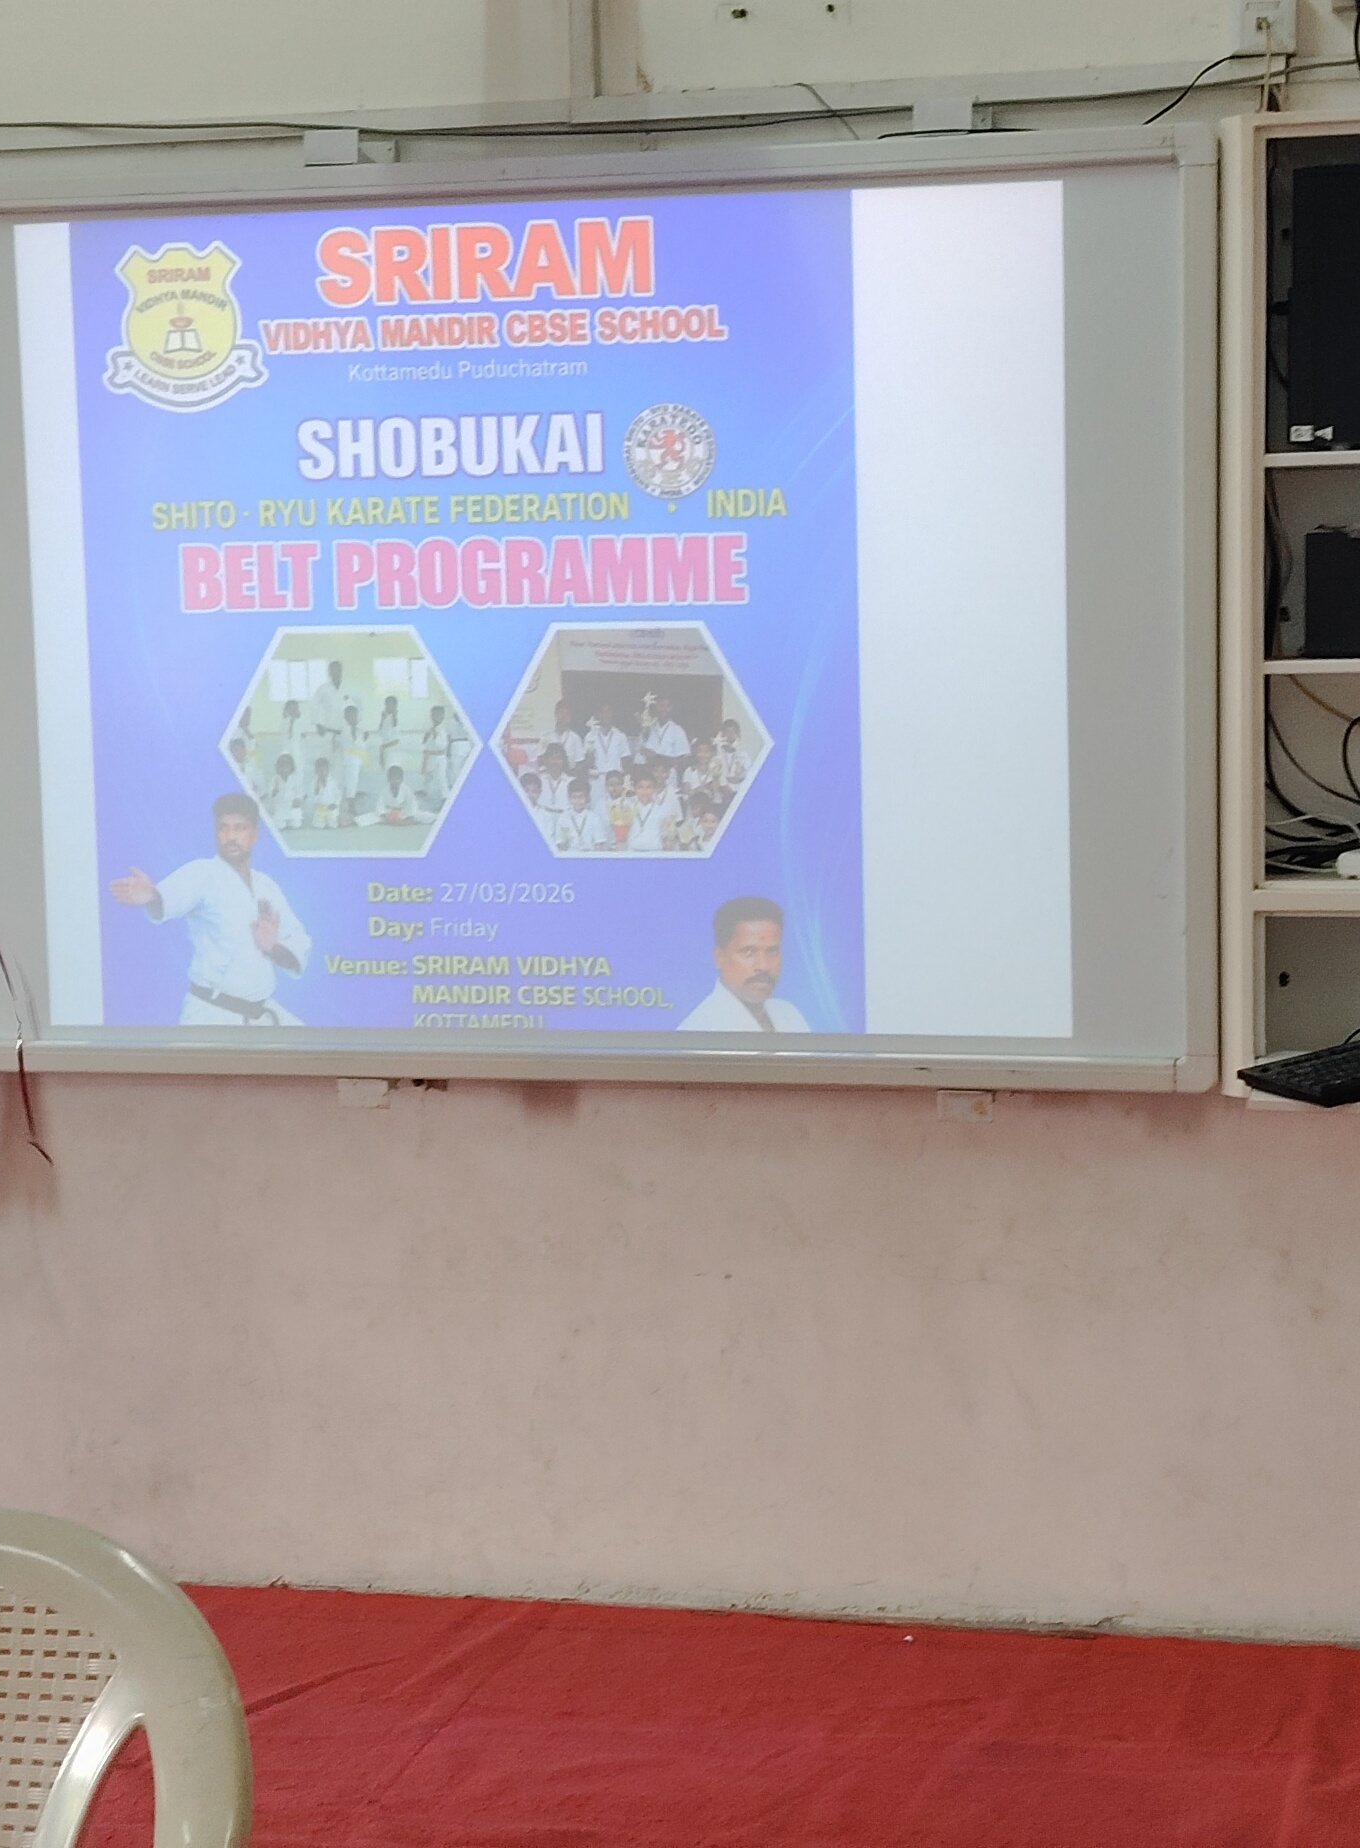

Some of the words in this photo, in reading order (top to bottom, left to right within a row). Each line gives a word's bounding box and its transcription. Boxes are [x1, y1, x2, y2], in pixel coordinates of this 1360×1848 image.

[317, 218, 654, 305] SRIRAM
[147, 267, 211, 284] SRIRAM
[262, 320, 372, 353] VIDHYA
[380, 314, 497, 349] MANDIR
[505, 311, 590, 344] CBSE
[595, 306, 727, 341] SCHOOL
[349, 360, 452, 382] Kottamedu
[459, 358, 588, 379] Puduchatram
[296, 412, 603, 480] SHOBUKAI
[151, 500, 237, 531] SHITO
[259, 498, 316, 528] RYU
[327, 495, 440, 526] KARATE
[449, 491, 629, 523] FEDERATION
[706, 487, 787, 519] INDIA
[180, 542, 321, 612] BELT
[333, 532, 749, 610] PROGRAMME
[367, 881, 433, 903] Date:
[439, 882, 575, 904] 27/03/2026
[368, 916, 424, 942] Day:
[430, 917, 499, 942] Friday
[324, 954, 408, 976] Venue:
[412, 955, 510, 976] SRIRAM
[517, 956, 612, 977] VIDHYA
[412, 985, 511, 1005] MANDIR
[517, 985, 575, 1007] CBSE
[582, 986, 676, 1010] SCHOOL,
